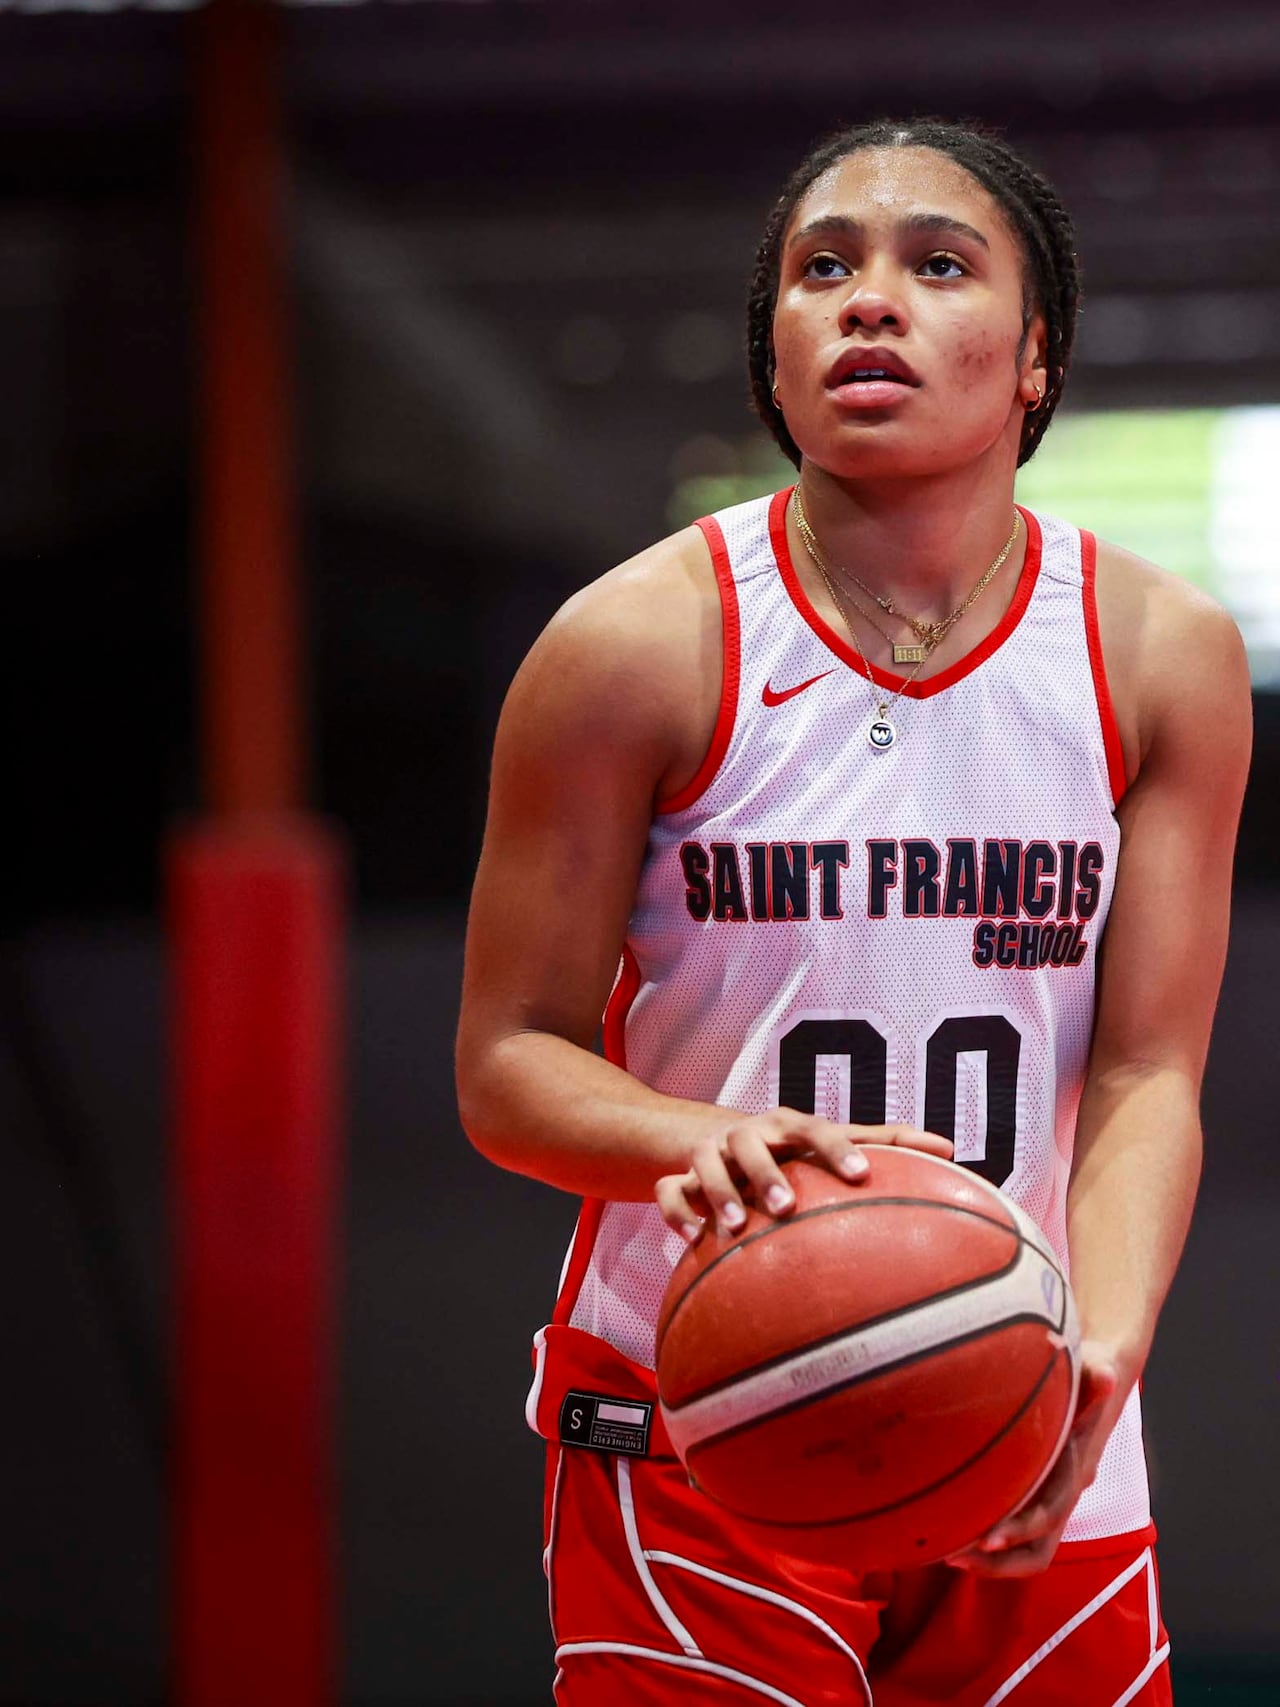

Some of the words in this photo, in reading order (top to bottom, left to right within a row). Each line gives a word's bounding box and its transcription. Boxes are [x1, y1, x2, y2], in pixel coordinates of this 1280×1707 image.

[679, 839, 850, 922] SAINT
[865, 838, 1104, 921] FRANCIS
[972, 920, 1088, 969] SCHOOL
[570, 1408, 583, 1430] S
